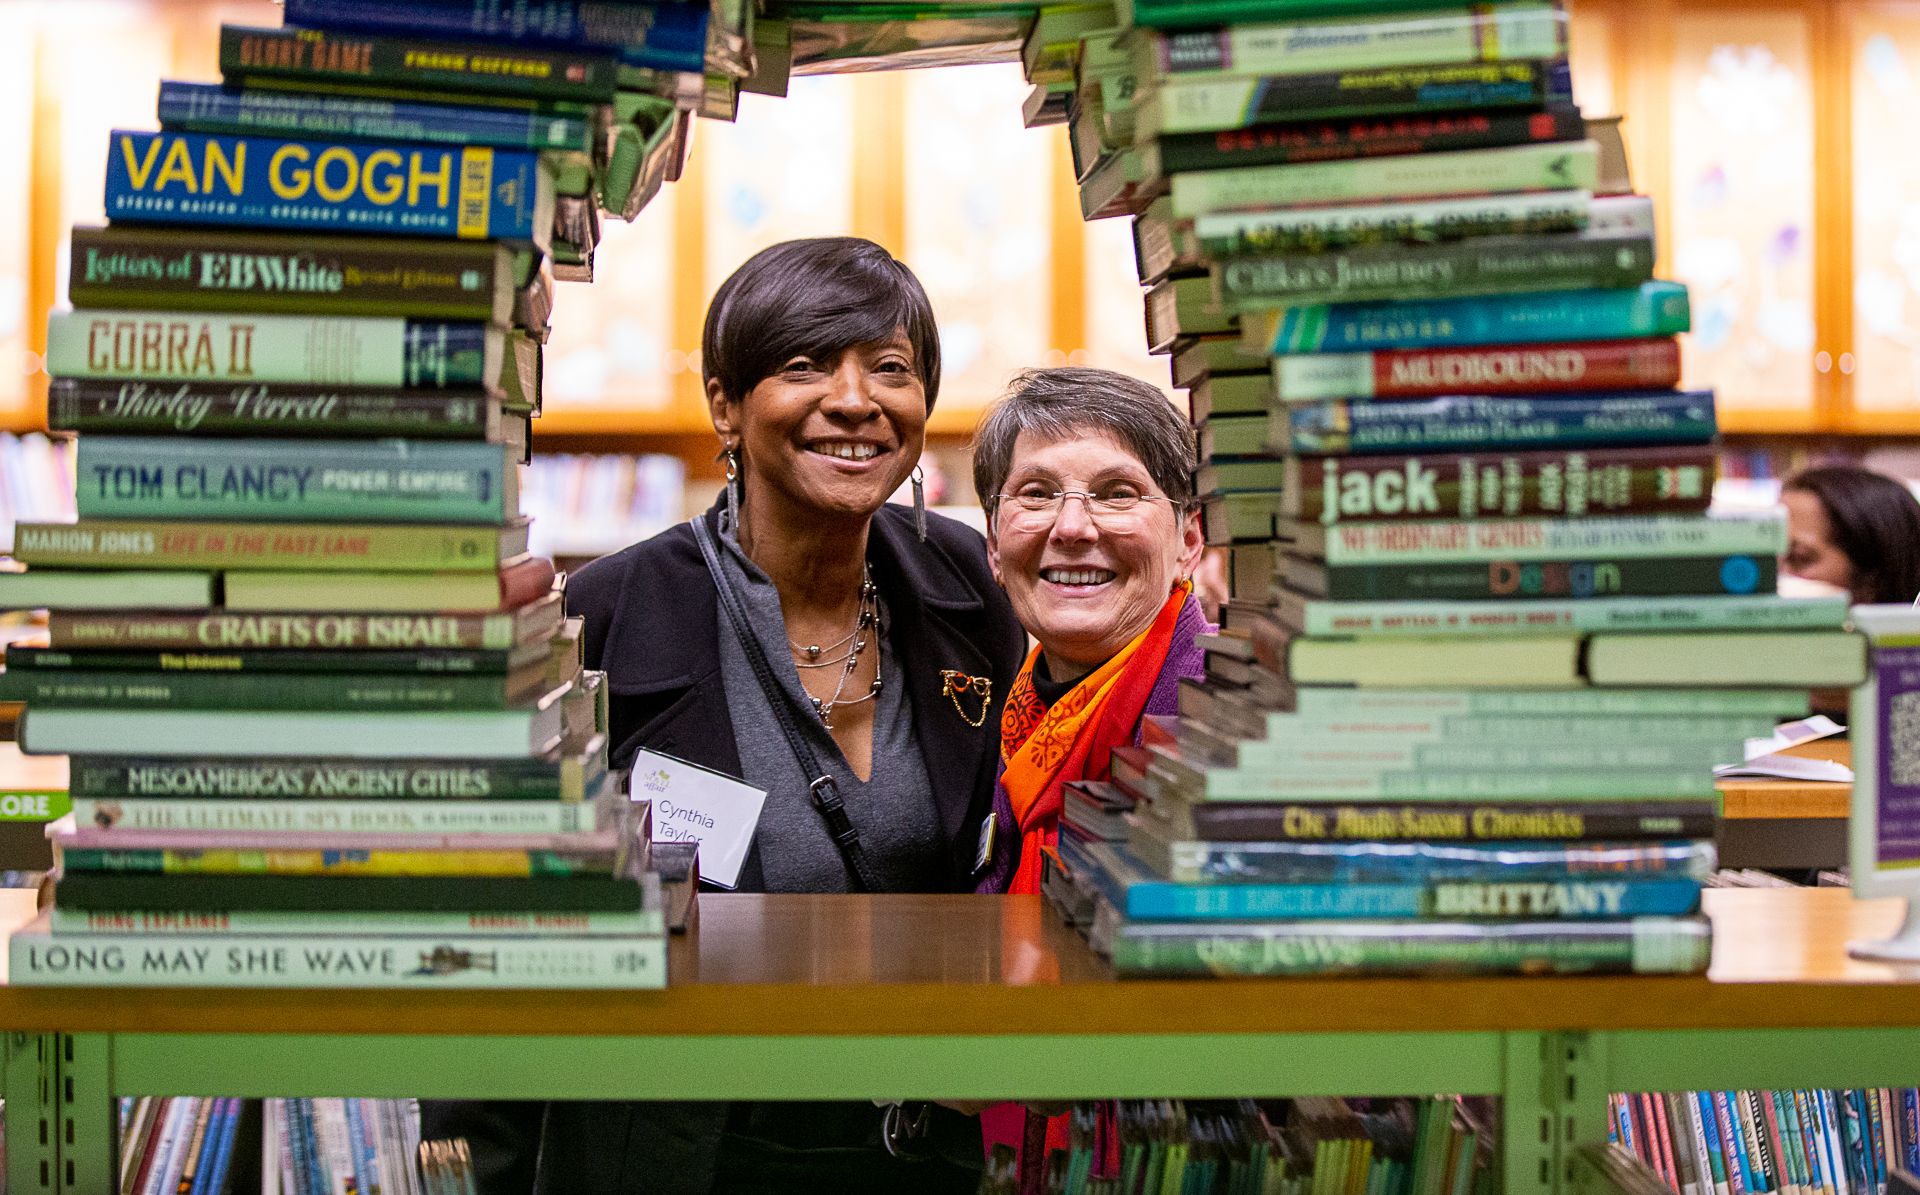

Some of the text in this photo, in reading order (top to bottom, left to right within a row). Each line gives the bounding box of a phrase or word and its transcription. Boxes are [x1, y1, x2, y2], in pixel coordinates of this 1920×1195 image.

[405, 51, 466, 71] FRANK
[121, 136, 247, 196] VAN
[268, 144, 452, 207] GOGH
[84, 248, 163, 282] Letters
[167, 251, 192, 280] of
[1225, 255, 1454, 292] Cilka's Journey
[87, 319, 216, 376] COBRA
[227, 323, 256, 376] II
[1390, 349, 1587, 386] MUDBOUND
[101, 381, 214, 430] Shirley
[230, 384, 338, 421] Verrett
[94, 465, 312, 501] TOM CLANCY
[1320, 458, 1440, 525] jack
[21, 530, 370, 557] MARION JONES LIFE IN THE FAST LANE
[199, 616, 312, 648] CRAFTS
[315, 616, 363, 648] OF
[366, 616, 464, 649] ISRAEL
[309, 768, 399, 797] ANCIENT
[411, 769, 491, 797] CITIES
[0, 795, 49, 817] ORE
[659, 800, 715, 829] Cynthia
[659, 821, 703, 846] Taylor
[1436, 883, 1627, 915] BRITTANY
[29, 946, 396, 976] LONG MAY SHE WAVE
